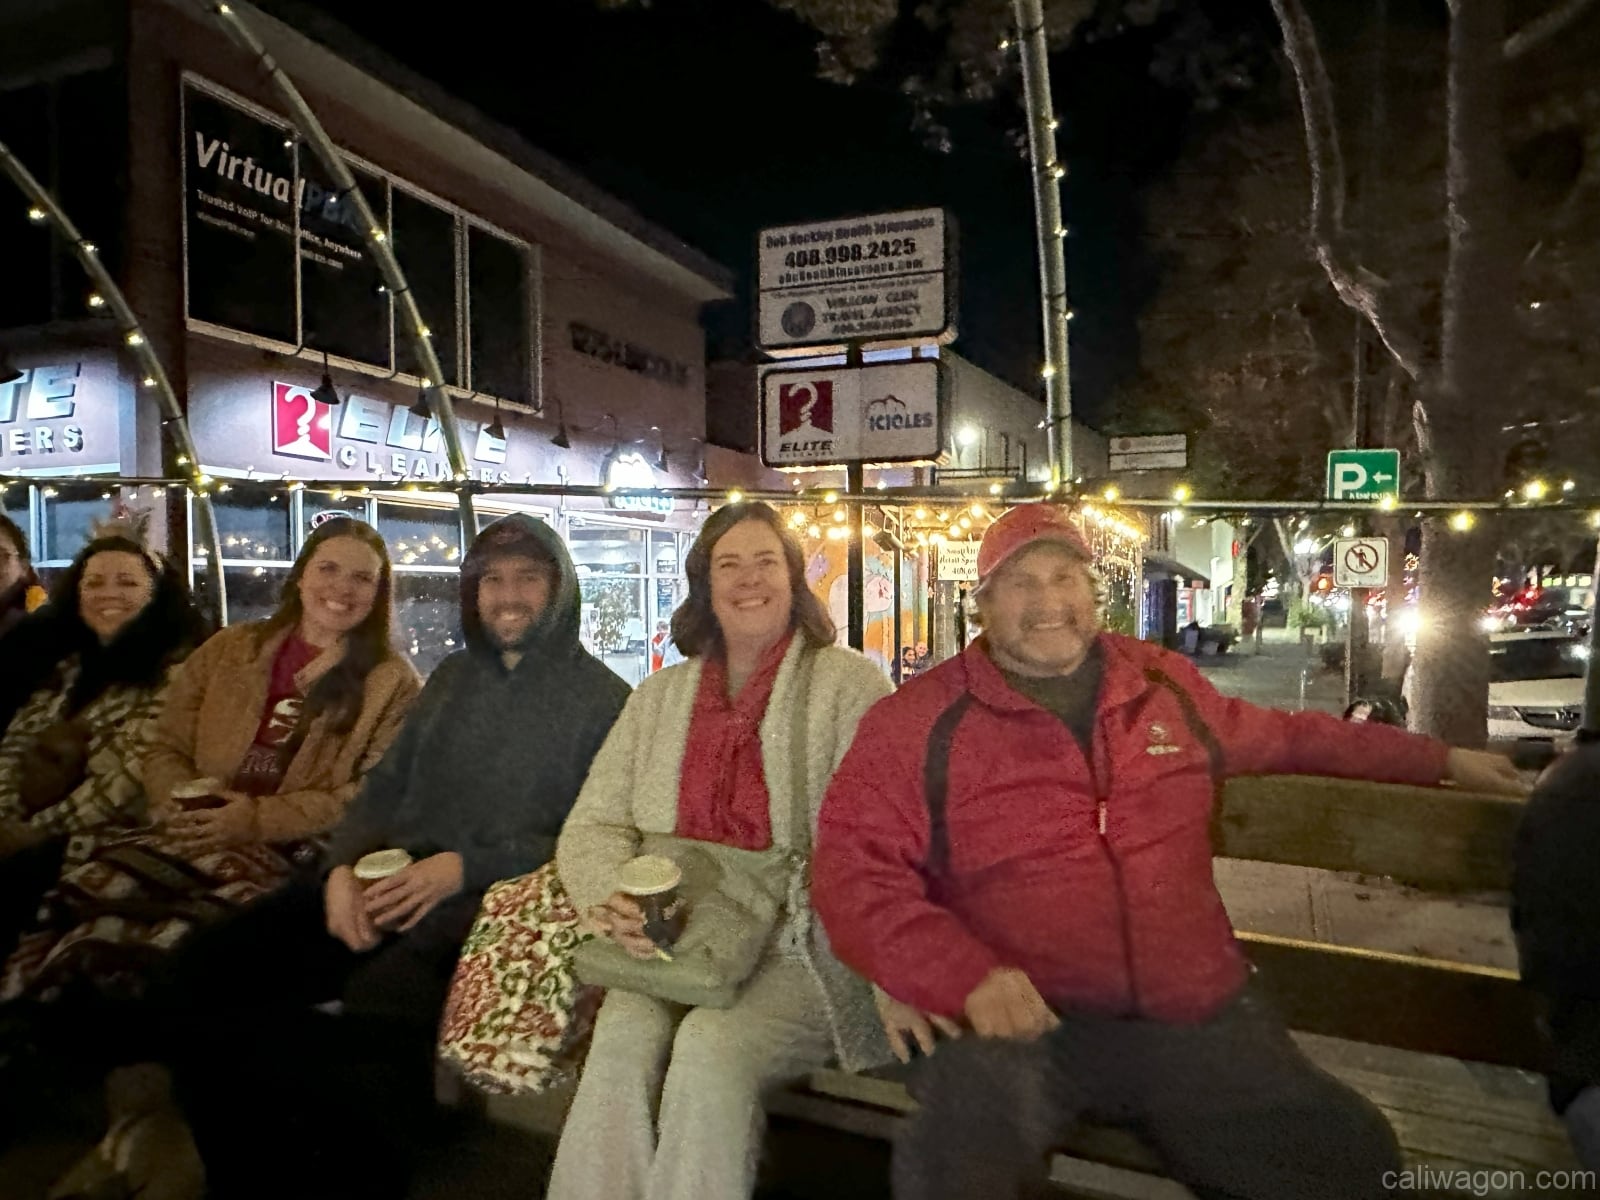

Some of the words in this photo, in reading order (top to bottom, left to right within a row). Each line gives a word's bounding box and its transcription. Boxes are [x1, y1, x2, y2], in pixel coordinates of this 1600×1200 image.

[785, 237, 916, 268] 408.998.2425
[340, 394, 508, 464] ELIE
[869, 412, 933, 432] ICICLES
[780, 440, 833, 453] ELITE
[1334, 463, 1367, 500] P
